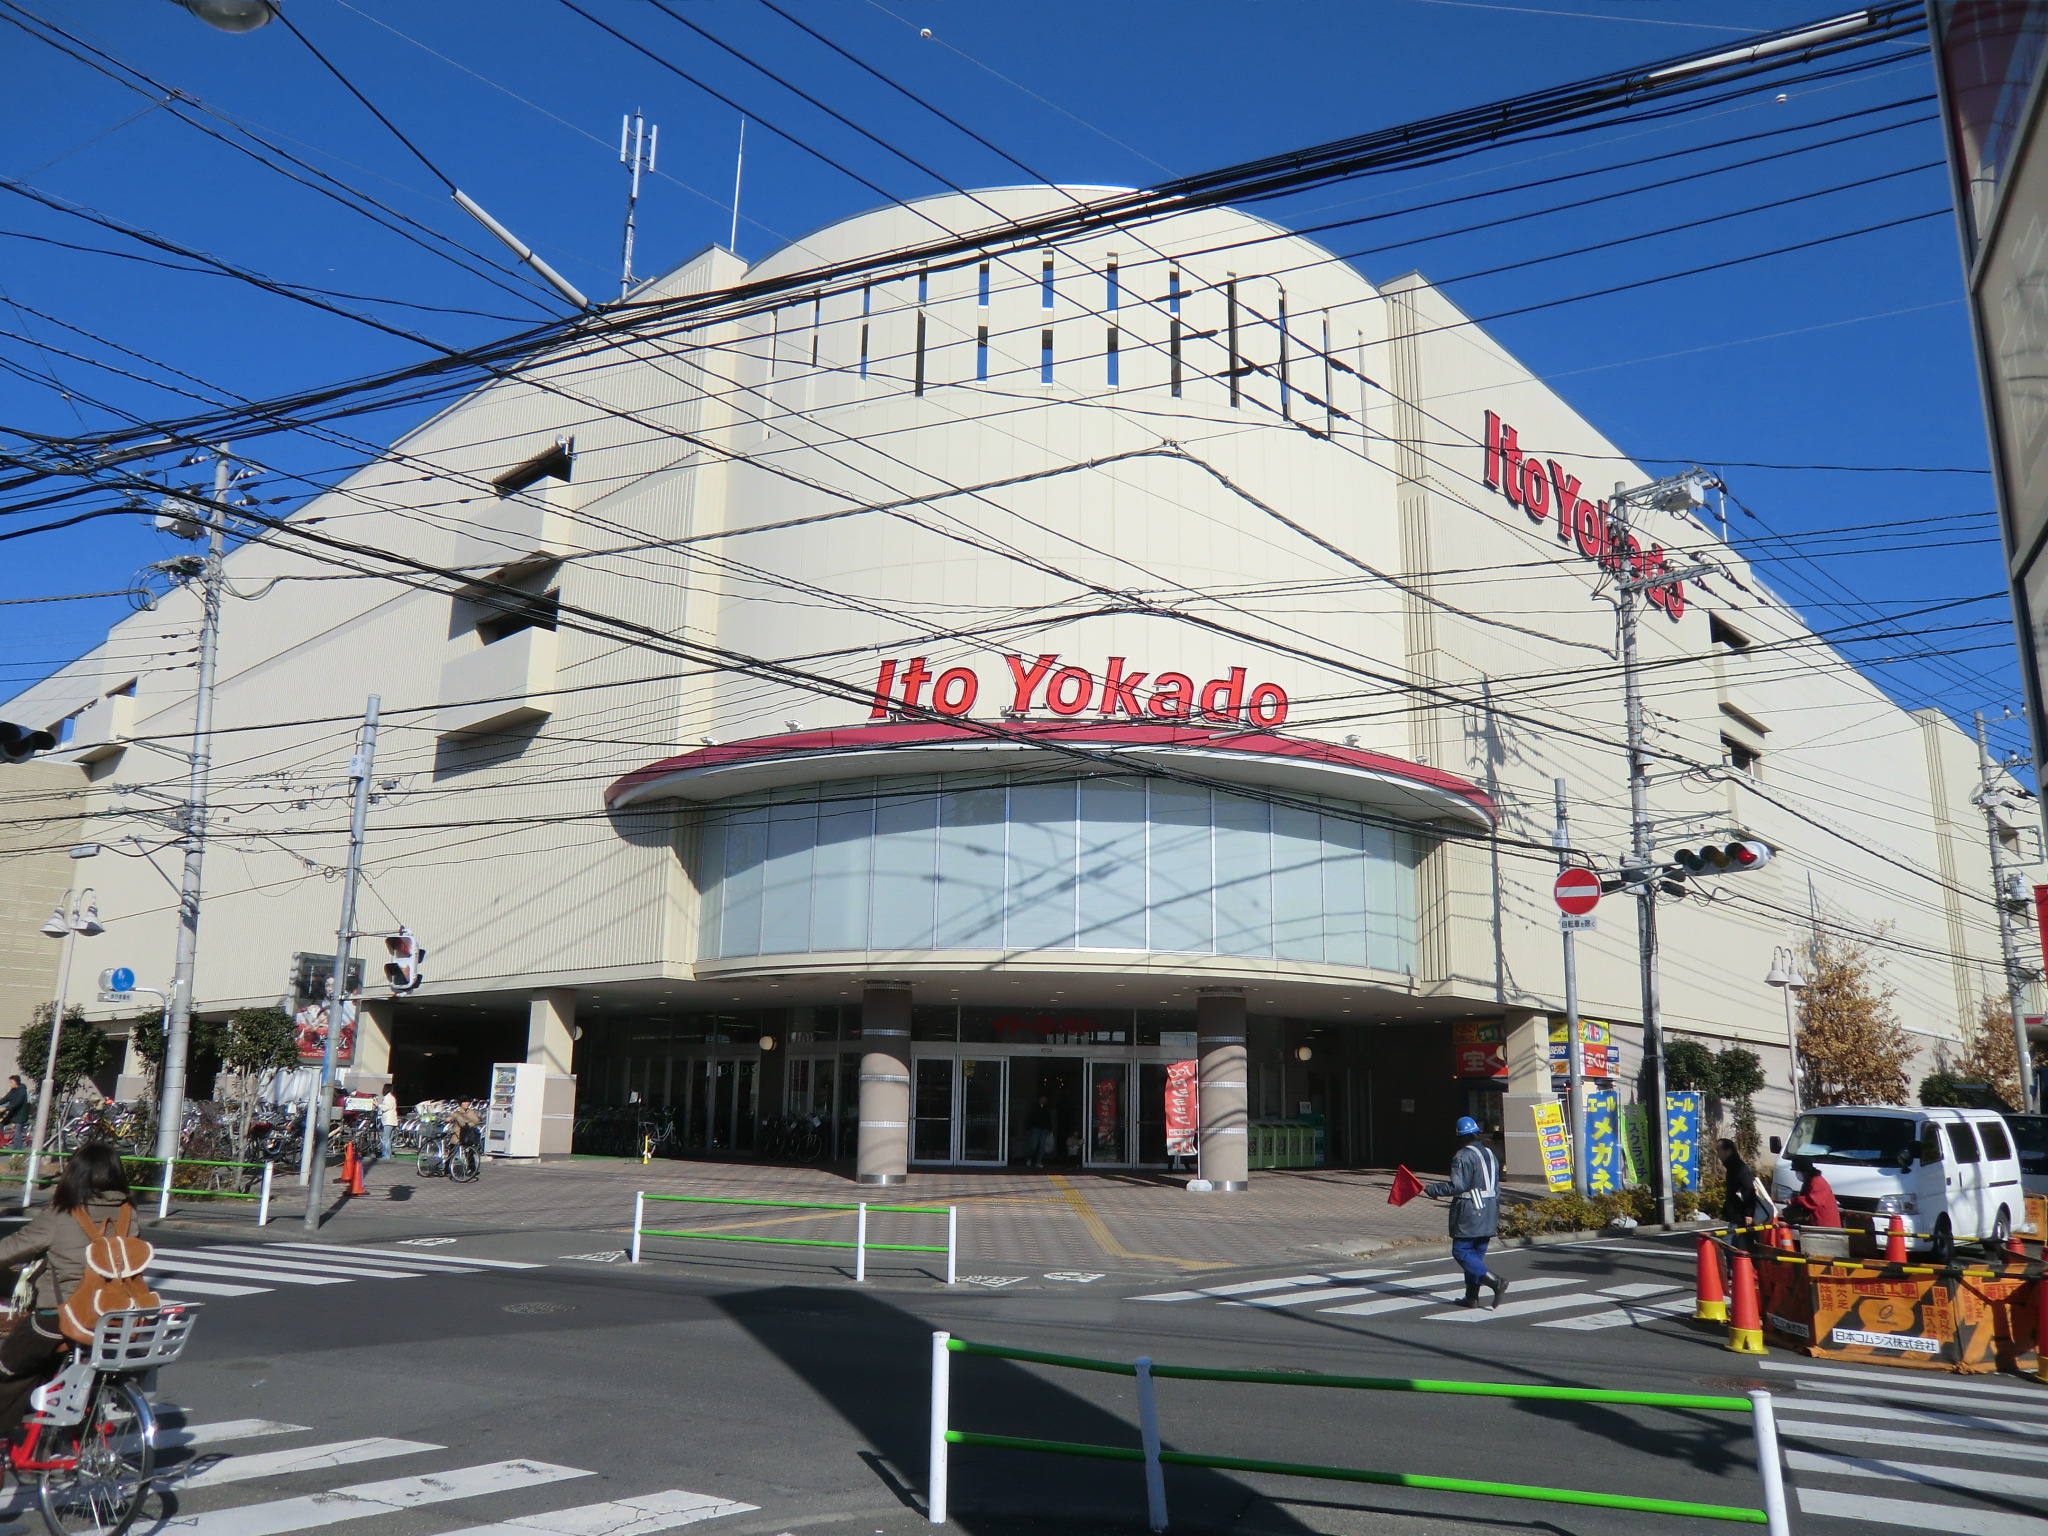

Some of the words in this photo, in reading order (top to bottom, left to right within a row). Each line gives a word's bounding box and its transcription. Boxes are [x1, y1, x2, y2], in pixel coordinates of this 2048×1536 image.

[1484, 409, 1549, 521] Ito
[868, 657, 979, 720] Ito
[1002, 654, 1289, 729] Yokado
[1587, 1096, 1616, 1112] エール
[1666, 1097, 1694, 1112] エール
[1590, 1117, 1614, 1194] メガネ
[1629, 1122, 1648, 1179] スクラッチ
[1669, 1116, 1691, 1188] メガネ
[1924, 1307, 1938, 1340] 立入禁
[1934, 1288, 1950, 1339] 関係者以外
[1835, 1331, 1937, 1352] 日本コムシス株式会社
